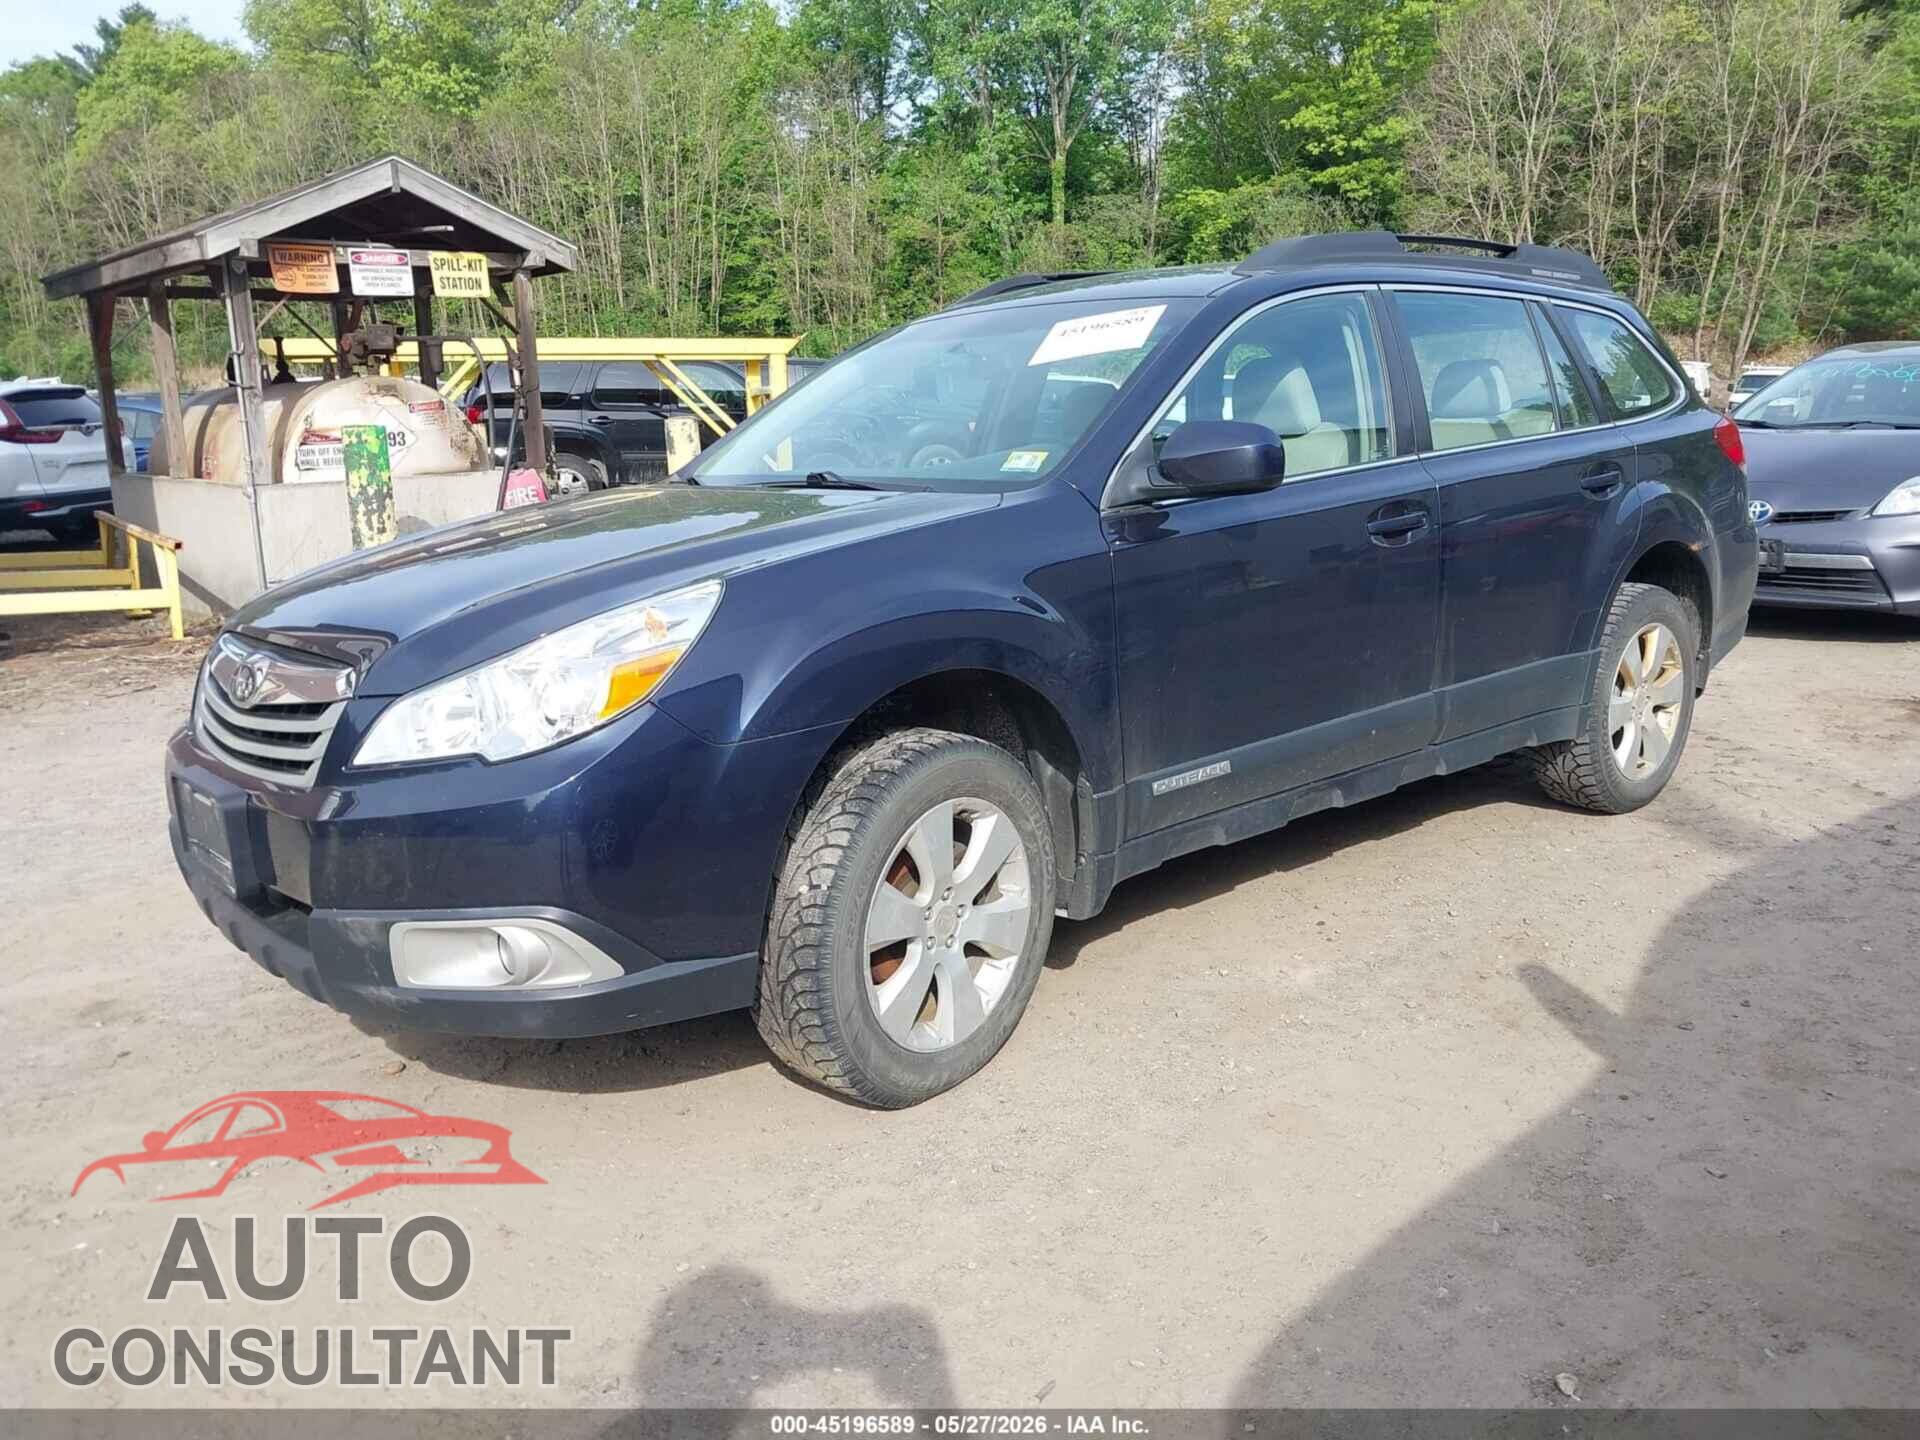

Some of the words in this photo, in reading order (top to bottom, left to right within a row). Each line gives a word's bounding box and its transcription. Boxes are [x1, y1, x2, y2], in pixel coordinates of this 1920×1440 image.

[278, 252, 325, 263] WARNING
[432, 256, 483, 272] SPILL-KIT
[439, 276, 483, 291] STATION
